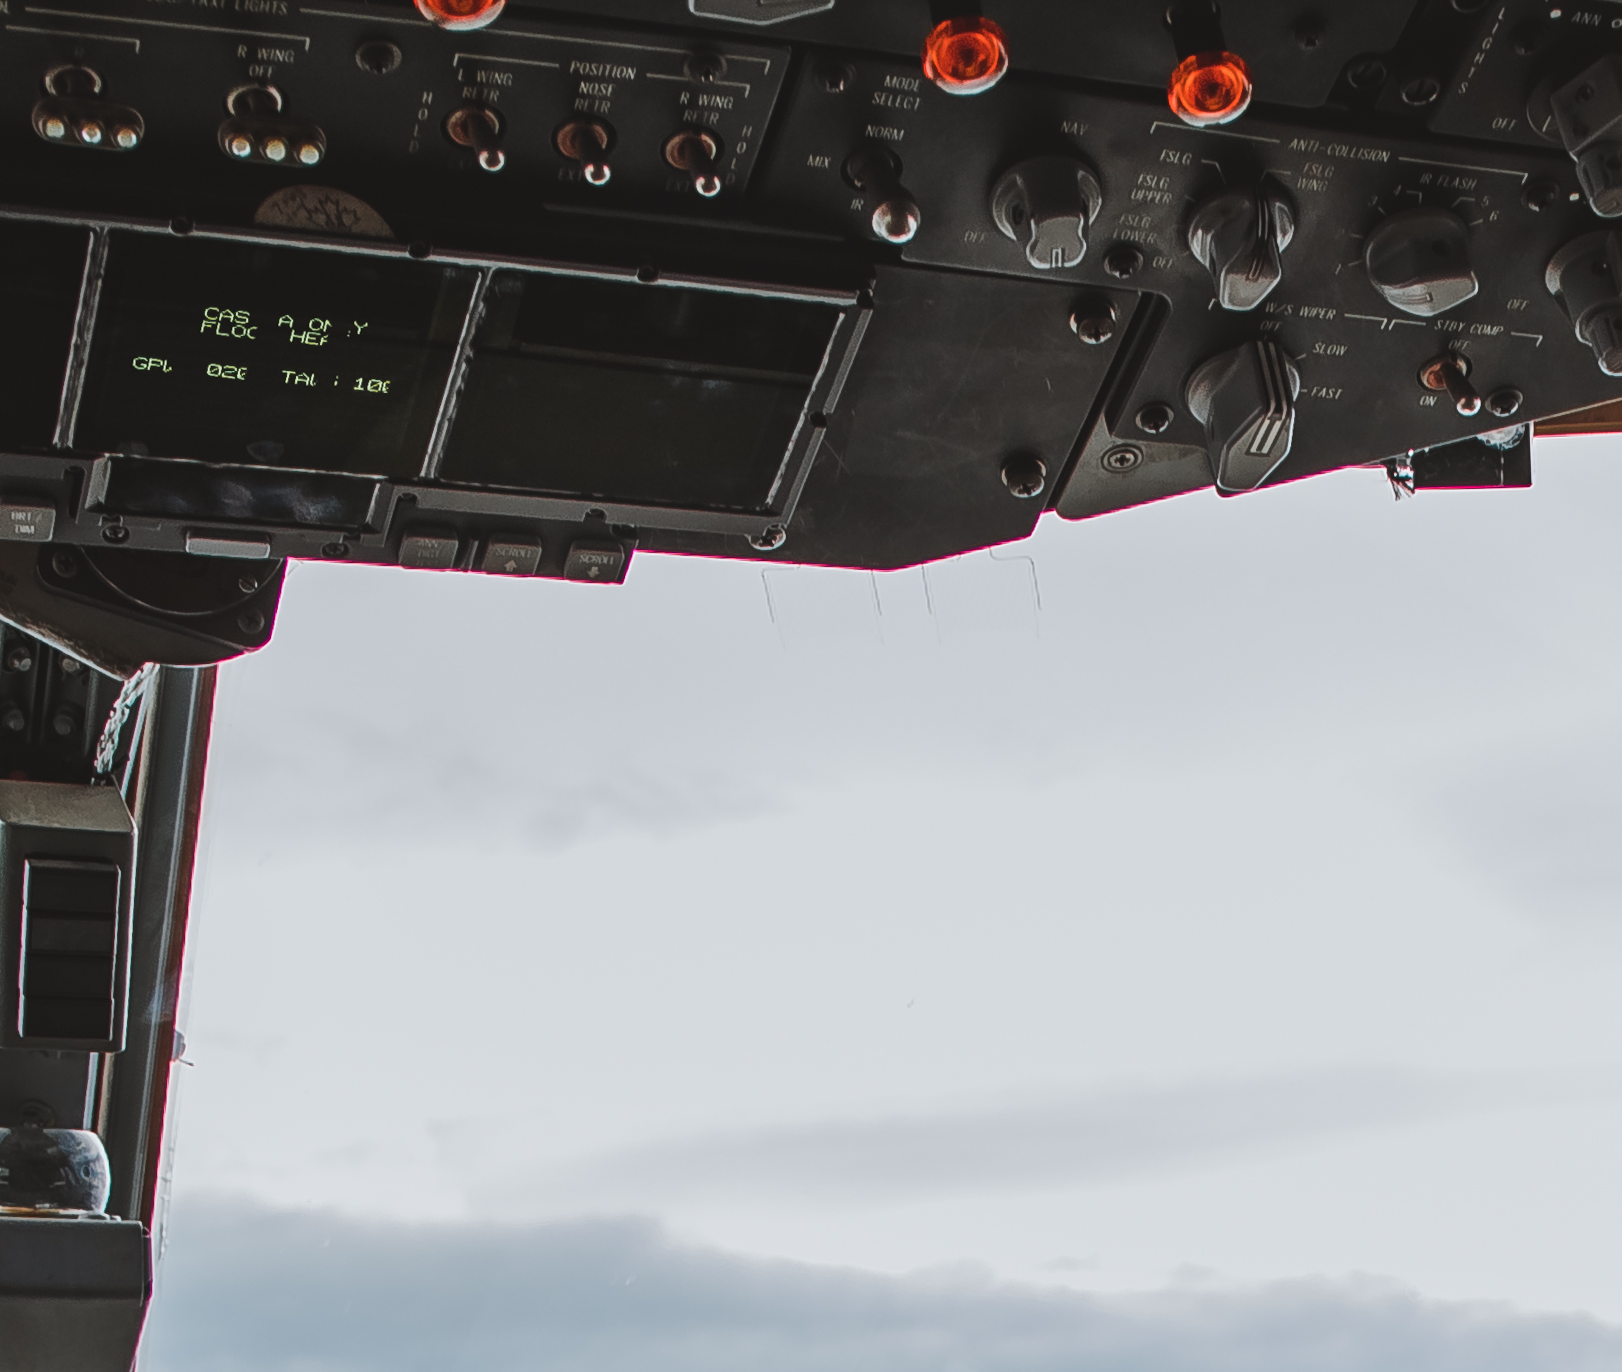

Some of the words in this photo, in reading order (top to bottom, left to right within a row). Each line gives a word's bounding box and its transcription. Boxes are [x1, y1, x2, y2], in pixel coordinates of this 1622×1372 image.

[570, 62, 637, 82] POSITION
[578, 82, 616, 98] NOSE
[884, 73, 922, 93] MODE
[1492, 118, 1516, 131] OFF
[1160, 149, 1192, 166] FSLG
[1288, 138, 1391, 162] ANTI-COLLISION
[1434, 319, 1462, 333] STBY
[1466, 322, 1504, 336] COMP
[1313, 341, 1347, 356] SLOW
[1311, 386, 1342, 400] FAST
